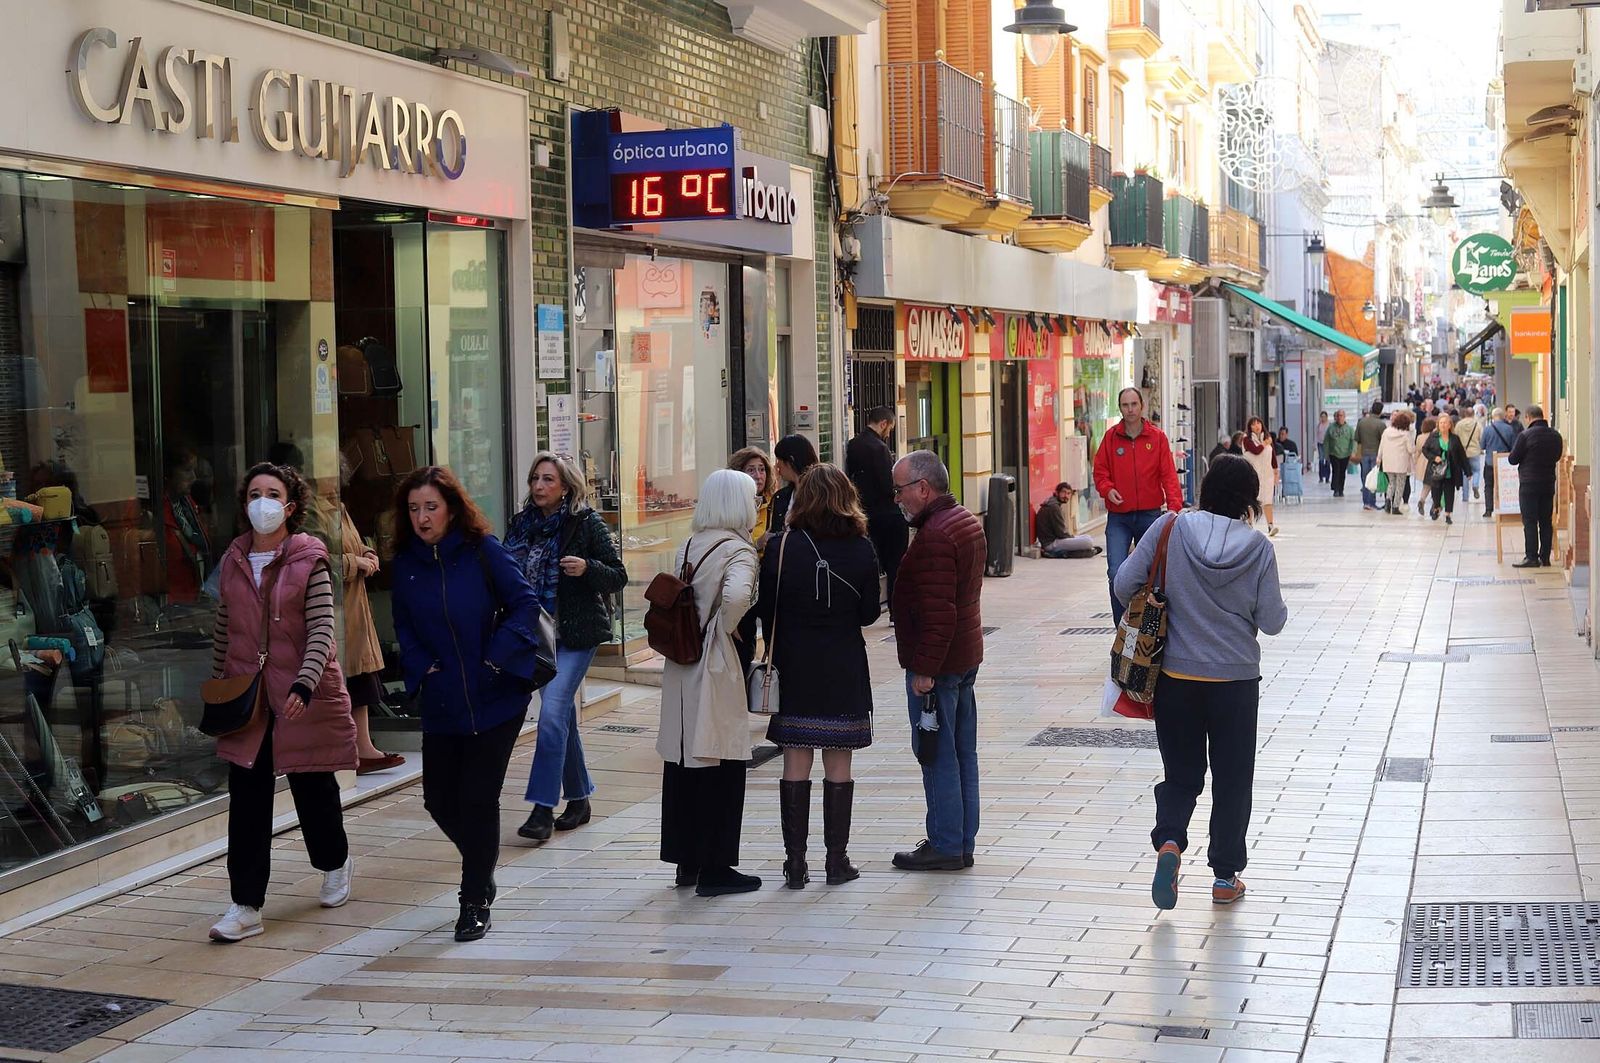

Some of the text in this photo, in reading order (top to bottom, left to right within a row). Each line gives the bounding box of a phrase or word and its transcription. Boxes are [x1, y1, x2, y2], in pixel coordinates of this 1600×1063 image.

[70, 28, 468, 179] CASTI GUIJARRO
[613, 141, 728, 163] óptica urbano
[631, 176, 663, 217] 16
